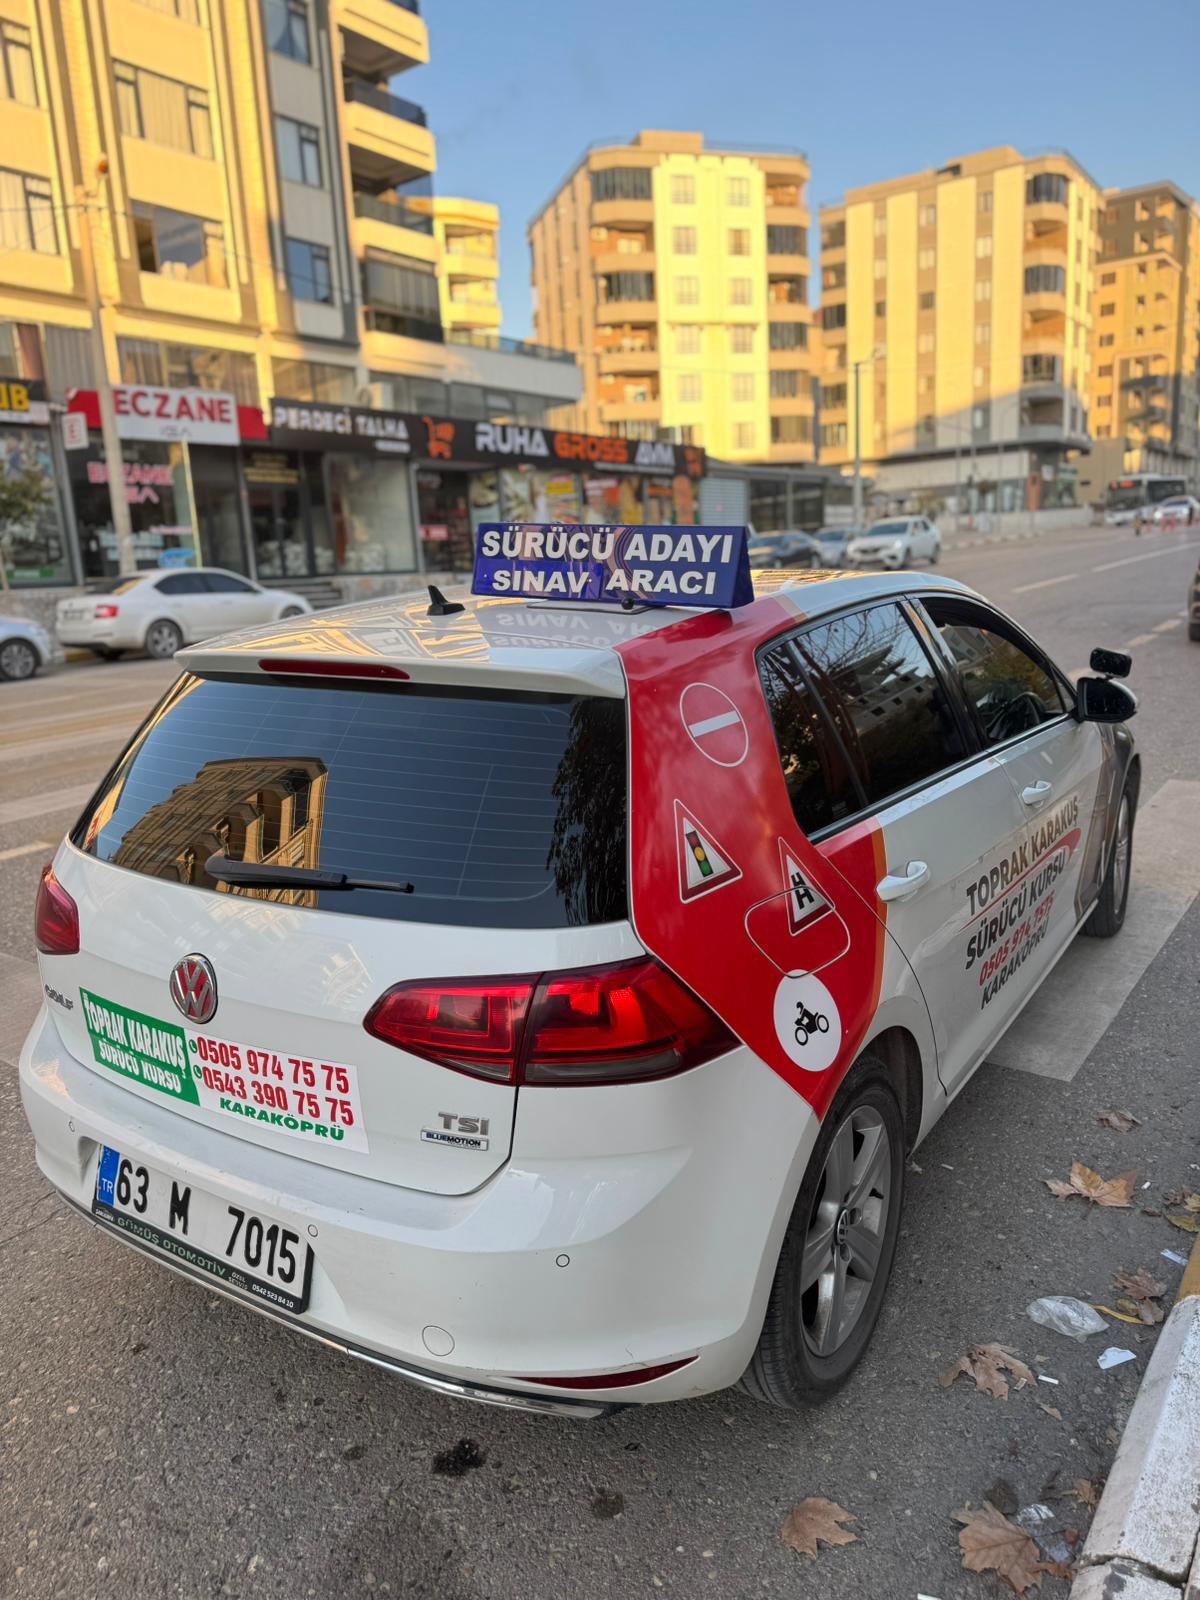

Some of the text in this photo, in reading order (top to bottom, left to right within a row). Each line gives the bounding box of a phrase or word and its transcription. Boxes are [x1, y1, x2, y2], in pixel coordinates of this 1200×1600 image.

[112, 389, 232, 423] ECZANE
[274, 406, 352, 434] PERDECİ
[475, 423, 549, 457] RUHA
[553, 432, 629, 463] GROSS
[482, 526, 615, 560] SÜRÜCÜ
[624, 534, 733, 563] ADAYI
[492, 569, 717, 595] SINAV ARACI
[966, 796, 1078, 916] TOPRAK KARAKUŞ
[965, 847, 1066, 970] SÜRÜCÜ KURSU
[979, 937, 1009, 986] 0505
[83, 999, 187, 1079] TOPRAK KARAKUŞ
[98, 1037, 183, 1094] SÜRÜCÜ KURSU
[197, 1036, 350, 1095] 0505 974 75 75
[202, 1066, 355, 1127] 0543 390 75 75
[219, 1097, 345, 1142] KARAKÖPRÜ
[426, 1131, 481, 1147] BLUEMOTION
[438, 1111, 490, 1136] TSI
[102, 1177, 113, 1195] TR
[116, 1158, 300, 1284] 63 M 7015
[162, 1238, 226, 1278] OTOMOTİV
